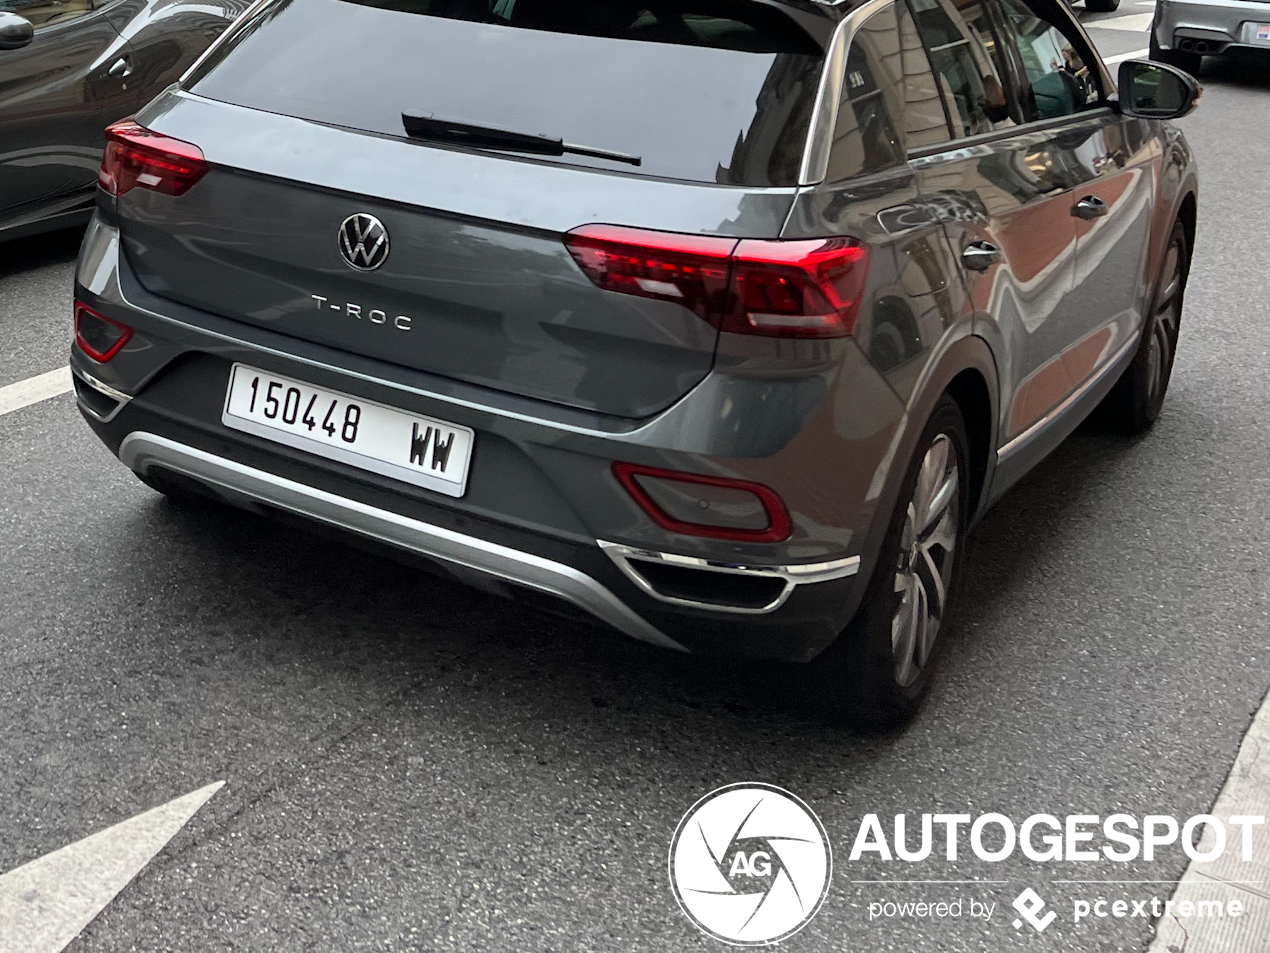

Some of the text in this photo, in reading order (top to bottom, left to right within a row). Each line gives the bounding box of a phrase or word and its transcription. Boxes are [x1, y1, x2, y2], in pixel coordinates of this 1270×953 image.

[311, 294, 412, 331] T-ROC
[248, 376, 455, 473] 150448 WW
